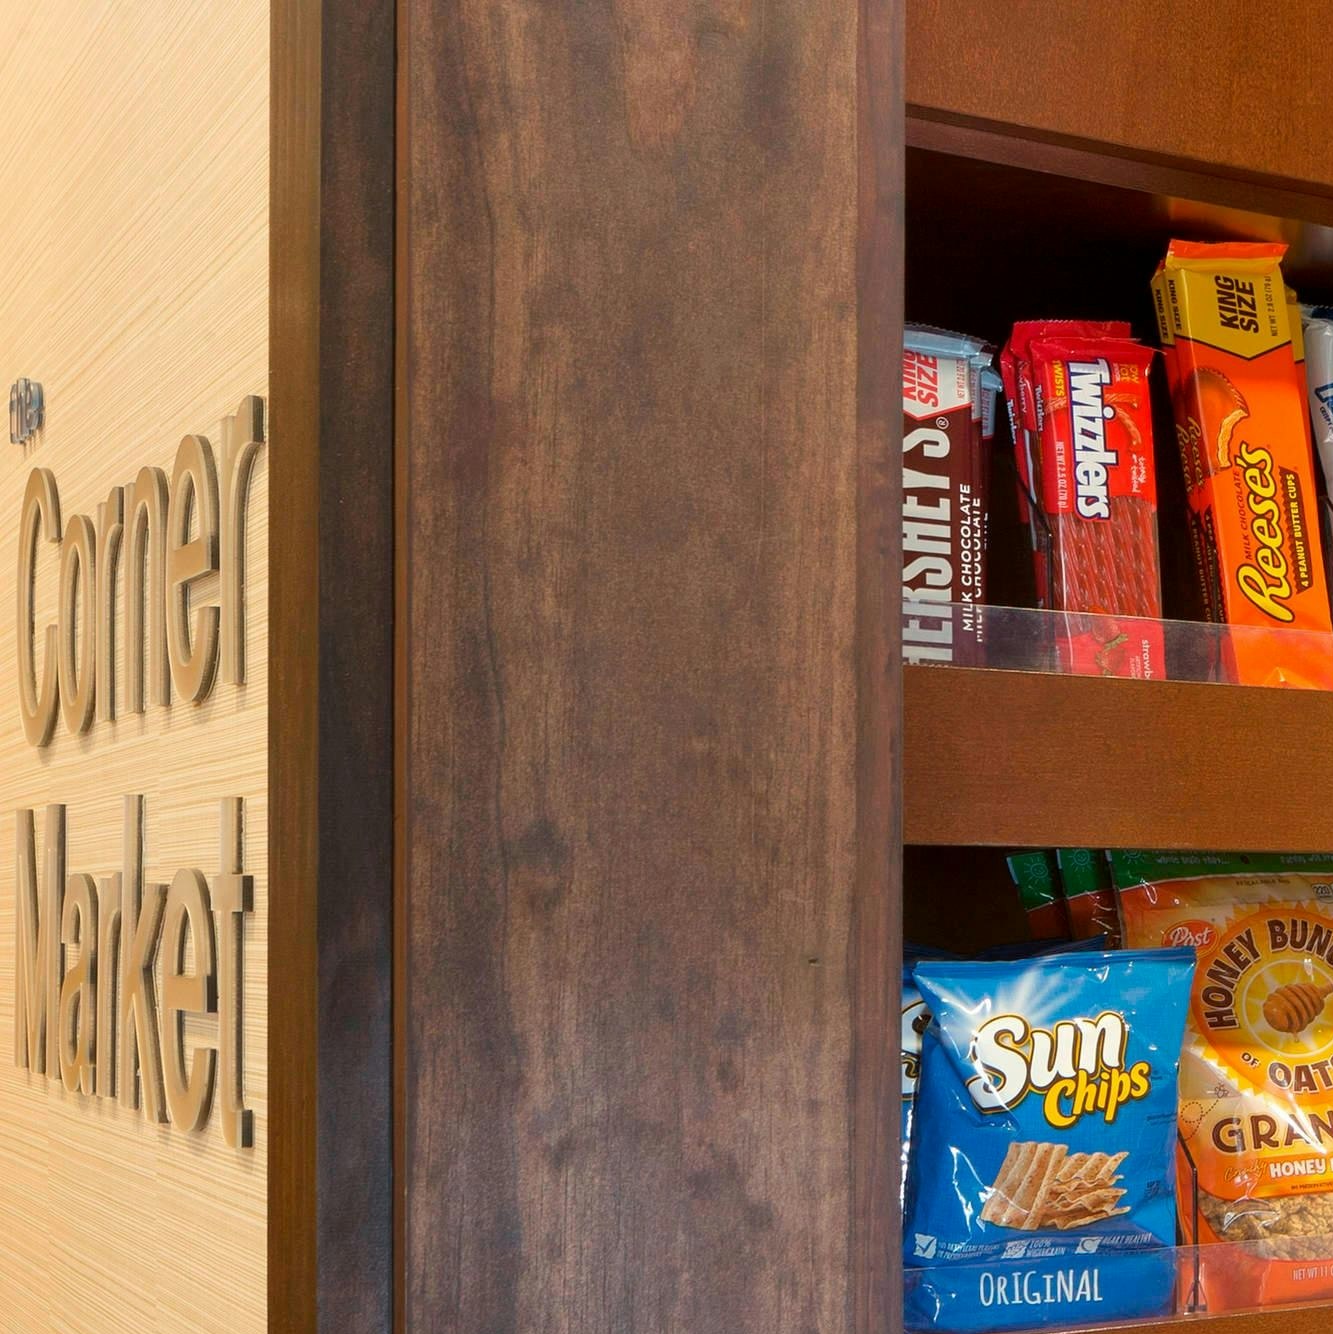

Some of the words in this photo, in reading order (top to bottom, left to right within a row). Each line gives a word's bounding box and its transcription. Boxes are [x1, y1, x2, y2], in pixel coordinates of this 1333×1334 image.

[1215, 275, 1240, 330] KING
[1234, 279, 1259, 334] SIZE
[1068, 358, 1118, 519] Twizzlers
[1233, 472, 1248, 530] CHOCOLATE
[1285, 473, 1296, 500] CUPS
[960, 483, 973, 585] CHOCOLATE
[1237, 441, 1295, 622] Reese's
[1241, 532, 1254, 560] MILK
[1291, 503, 1302, 540] BUTTER
[15, 395, 264, 747] Corner
[1297, 547, 1309, 578] PEANUT
[962, 592, 974, 632] MILK
[1170, 926, 1211, 946] Post
[15, 795, 255, 1148] Market
[1201, 927, 1262, 1031] HONEY
[971, 1010, 1130, 1115] Sun
[1241, 1052, 1260, 1068] OF
[1043, 1059, 1153, 1129] Chips
[1269, 1159, 1326, 1179] HONEY
[979, 1268, 1103, 1307] ORIGINAL
